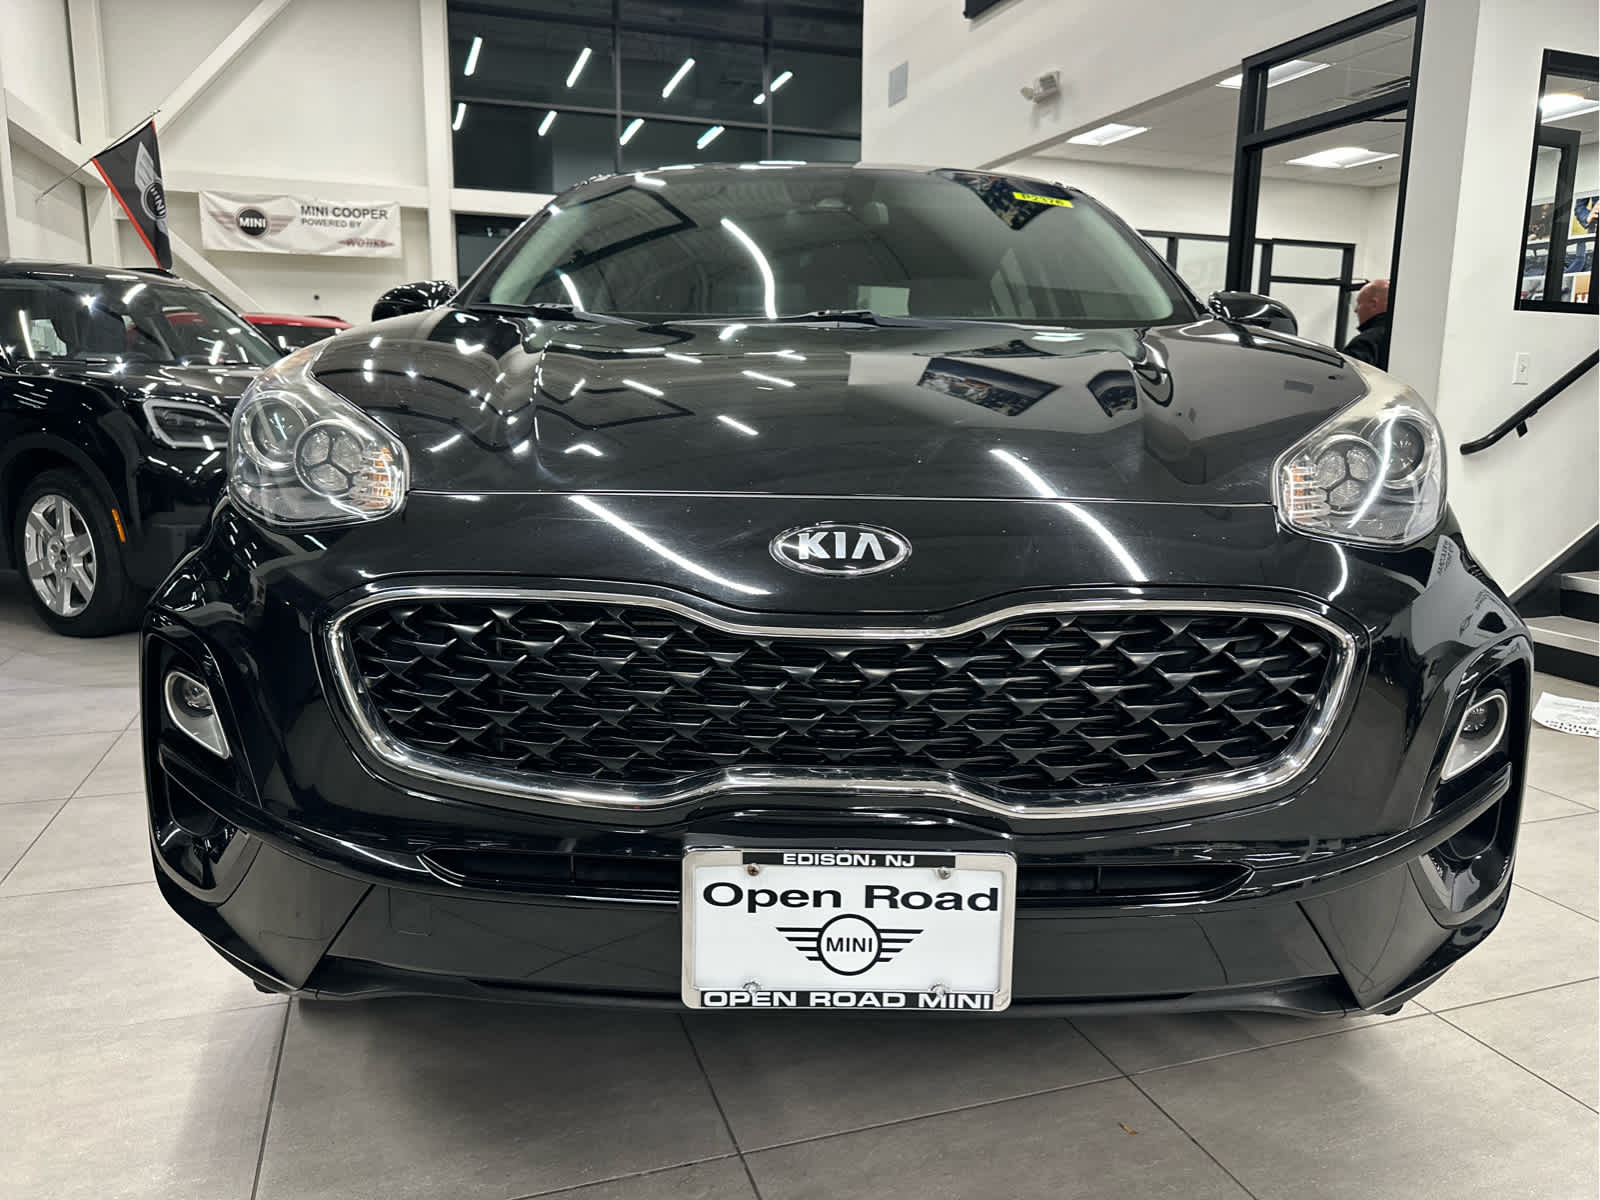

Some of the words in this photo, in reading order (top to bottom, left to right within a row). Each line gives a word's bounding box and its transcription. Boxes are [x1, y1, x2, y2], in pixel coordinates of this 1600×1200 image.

[300, 205, 329, 217] MINI
[332, 207, 388, 220] COOPER
[239, 217, 266, 228] MINI
[301, 217, 348, 228] POWERED
[349, 219, 361, 228] BY
[797, 531, 886, 561] KIA
[783, 853, 876, 867] EDISON,
[885, 854, 915, 867] NJ
[703, 882, 842, 913] Open
[864, 884, 999, 912] Road
[826, 937, 873, 953] MINI
[703, 990, 797, 1007] OPEN
[809, 991, 906, 1008] ROAD
[918, 992, 993, 1009] MINI
